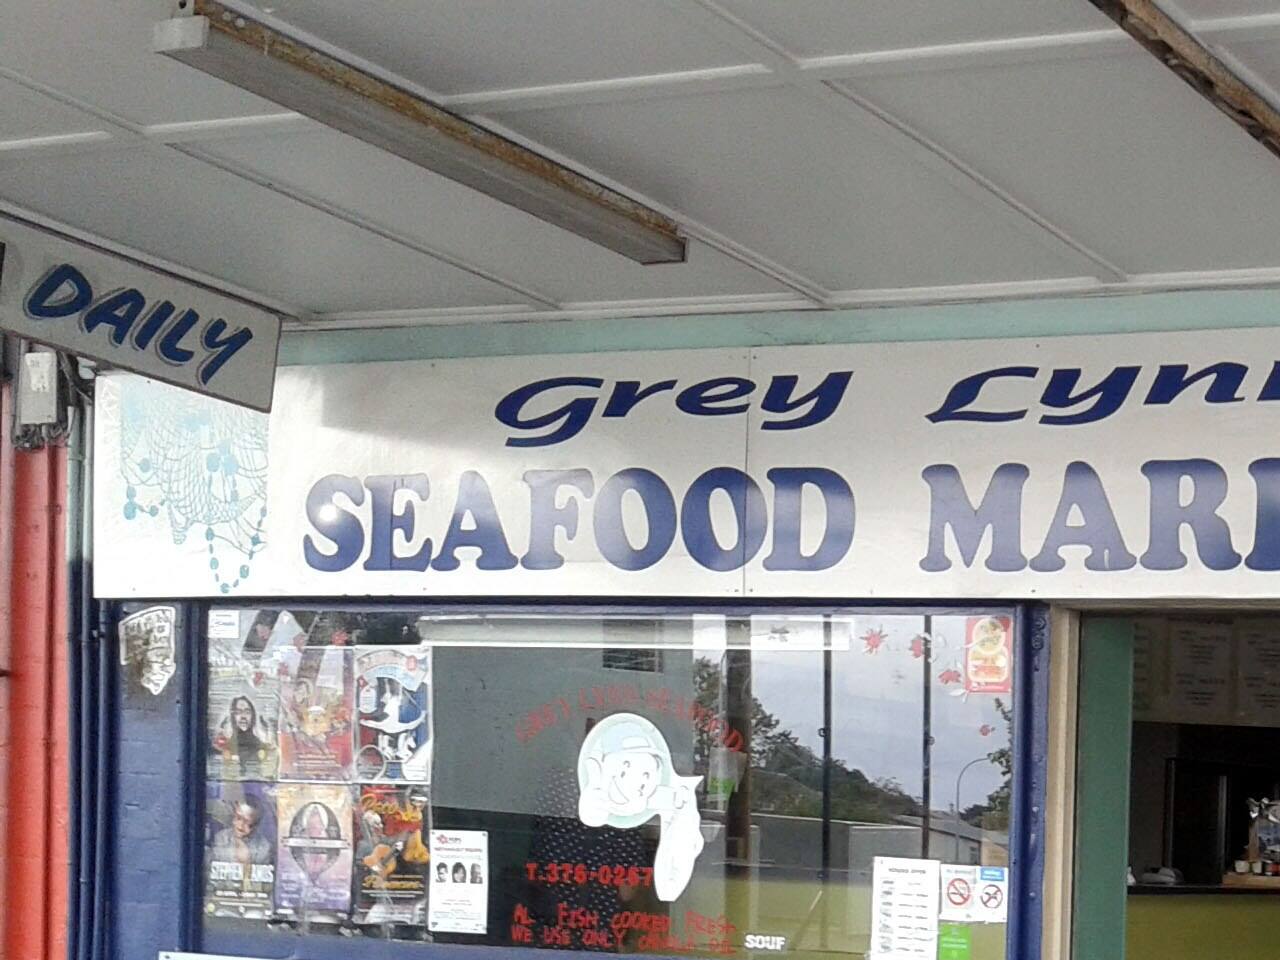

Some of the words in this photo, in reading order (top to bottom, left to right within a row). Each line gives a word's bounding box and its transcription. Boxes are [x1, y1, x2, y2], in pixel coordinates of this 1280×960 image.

[23, 263, 253, 386] DAILY
[495, 370, 854, 447] Grey
[303, 466, 856, 571] SEAFOOD
